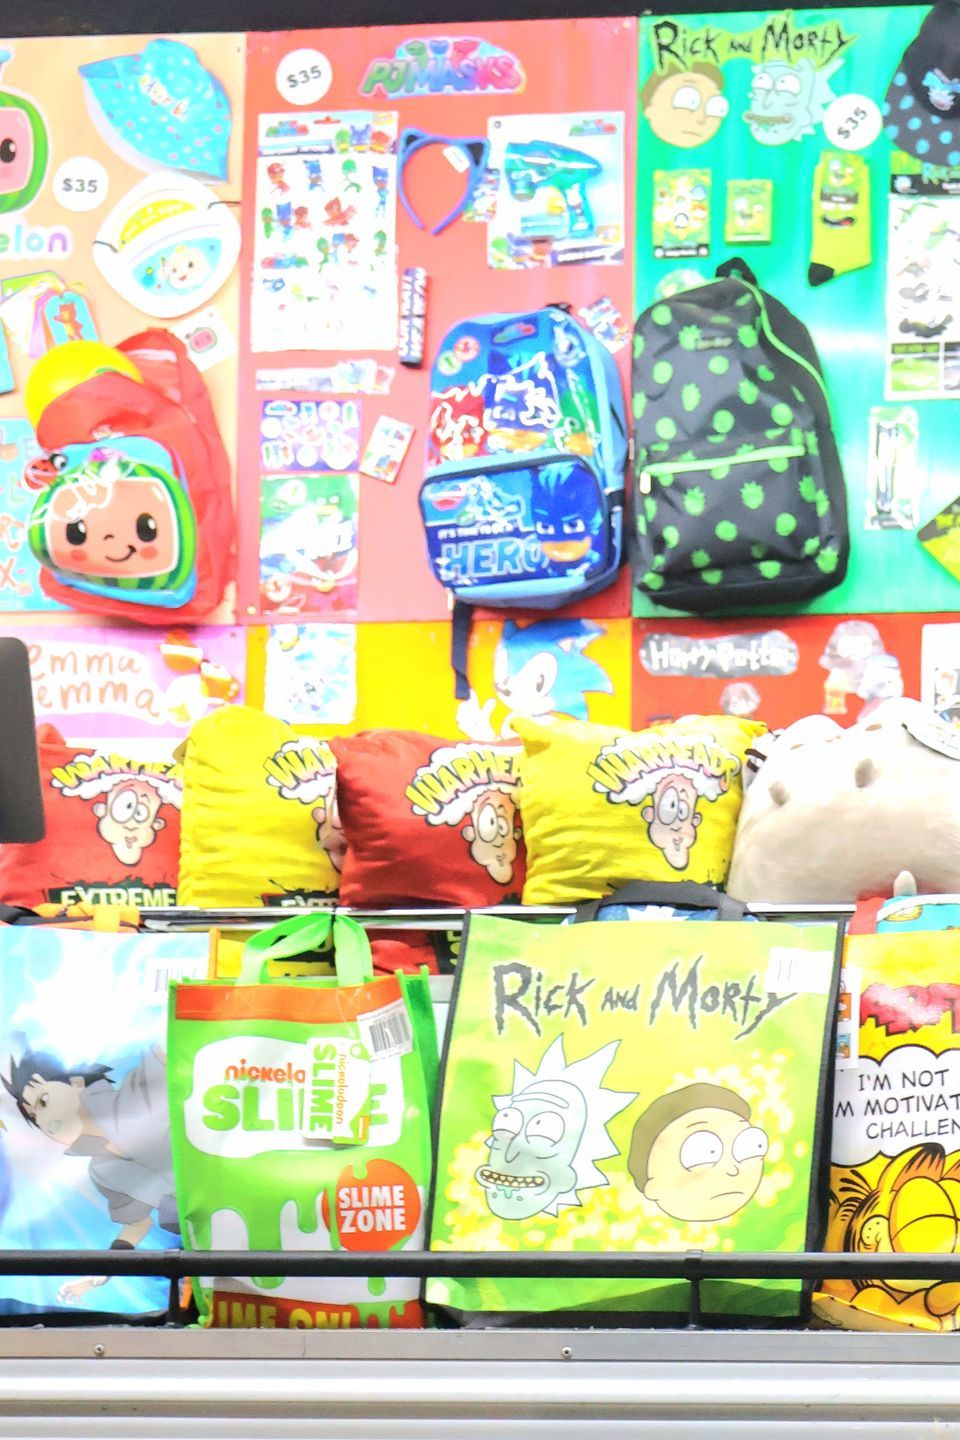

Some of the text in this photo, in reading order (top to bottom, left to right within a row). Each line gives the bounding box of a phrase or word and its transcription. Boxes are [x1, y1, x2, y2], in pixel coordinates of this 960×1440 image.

[654, 21, 719, 71] Rick
[286, 64, 322, 88] $35
[837, 107, 868, 140] $35
[61, 177, 98, 193] $35
[34, 680, 162, 718] emma
[404, 750, 522, 815] WARHEA
[493, 961, 596, 1037] Rick
[225, 1058, 306, 1084] nickelo
[858, 1073, 892, 1092] I'M
[902, 1069, 949, 1088] NOT
[309, 1043, 337, 1133] SLIME
[338, 1185, 405, 1209] SLIME
[340, 1208, 407, 1234] ZONE
